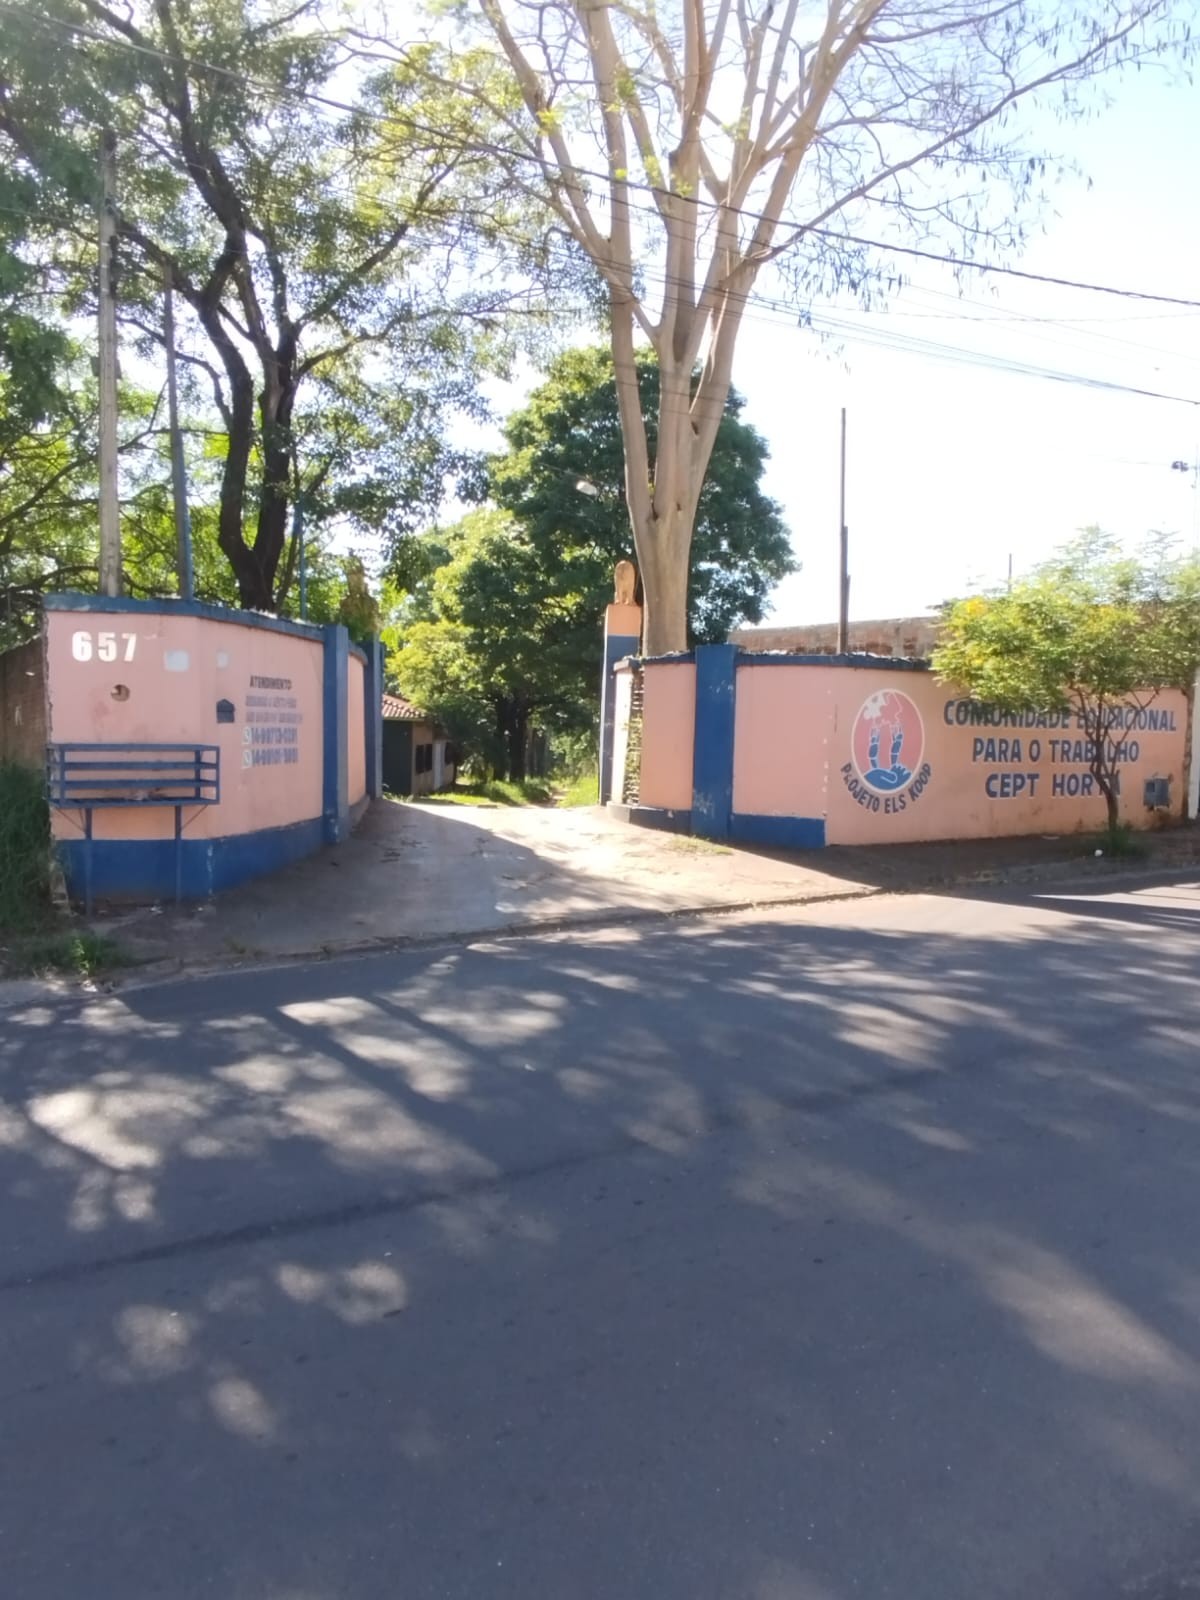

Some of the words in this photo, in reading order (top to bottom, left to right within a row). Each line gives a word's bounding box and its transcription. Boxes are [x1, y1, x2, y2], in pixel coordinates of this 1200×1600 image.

[72, 631, 137, 662] 657
[972, 737, 1022, 763] PARA
[1028, 739, 1042, 763] O
[884, 794, 906, 815] ELS
[907, 762, 931, 802] KOOP
[984, 772, 1040, 798] CEPT
